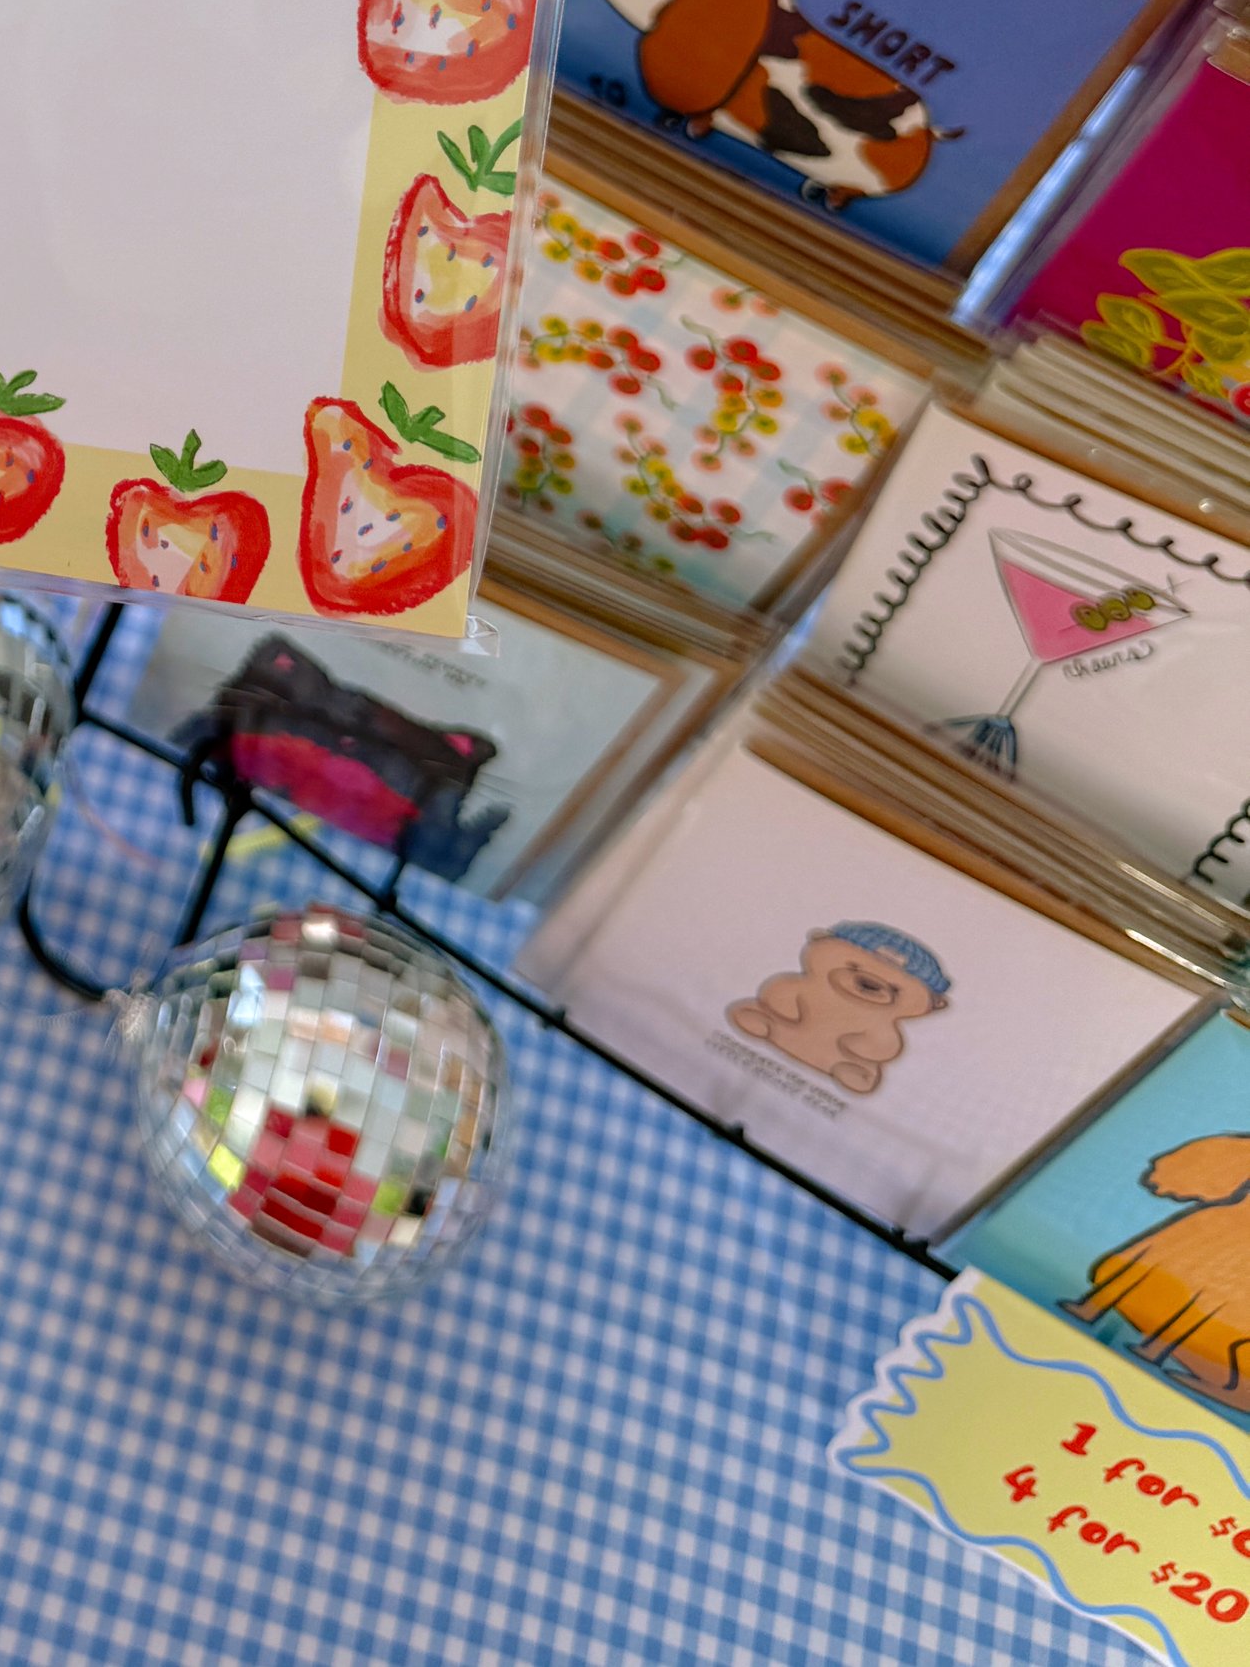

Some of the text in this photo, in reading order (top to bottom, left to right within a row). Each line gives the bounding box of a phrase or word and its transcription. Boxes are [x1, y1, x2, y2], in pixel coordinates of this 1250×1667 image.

[826, 1, 956, 86] SHORT
[1060, 1422, 1097, 1456] 1
[1103, 1457, 1200, 1508] for
[1002, 1465, 1250, 1624] 4 for $20
